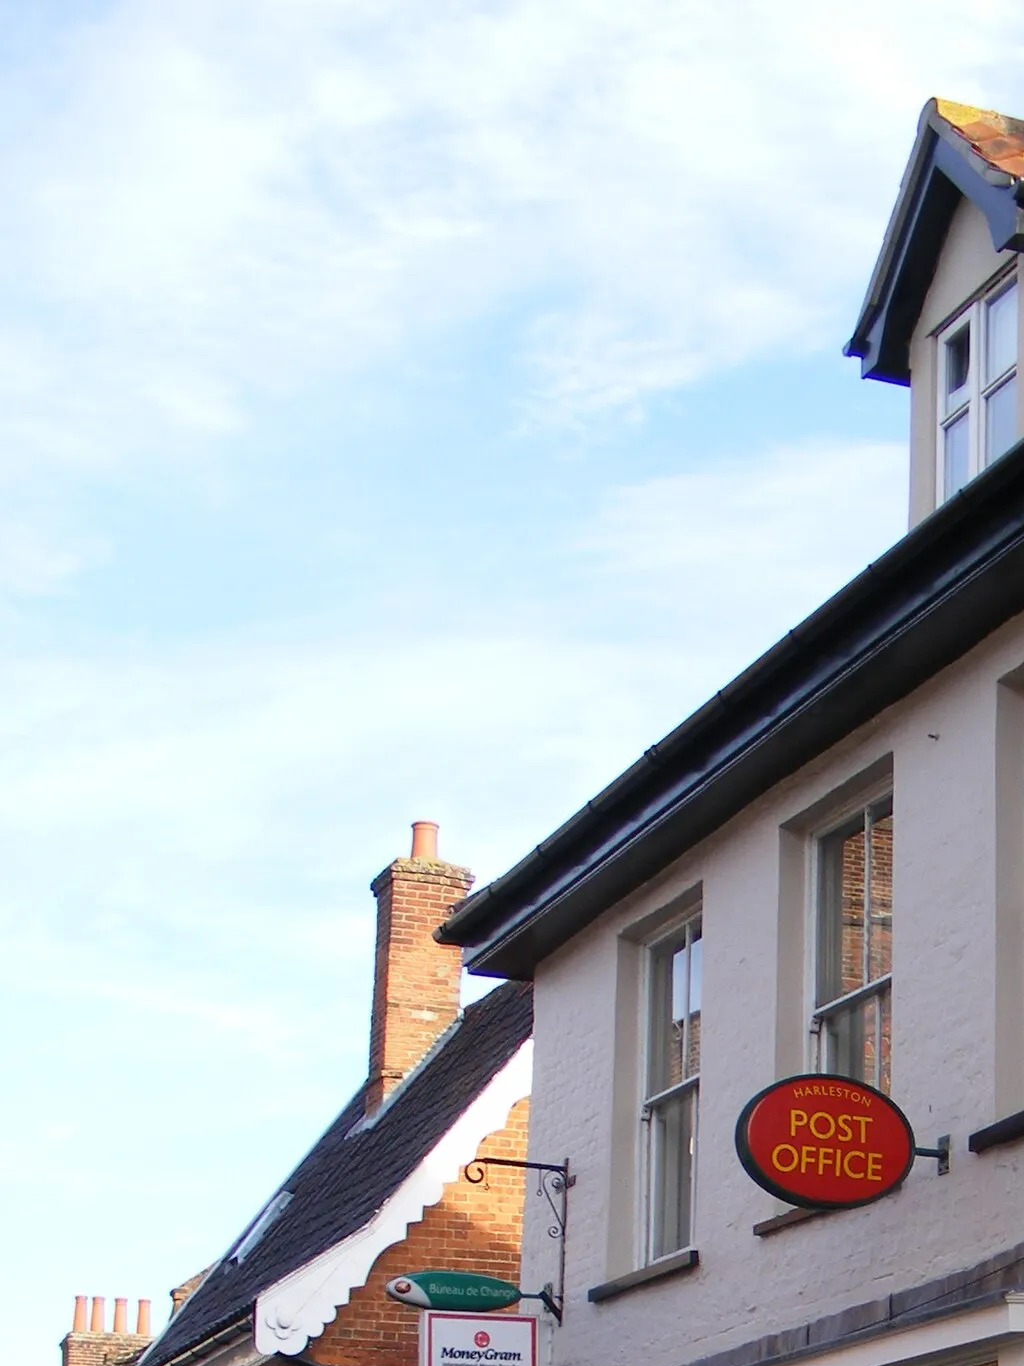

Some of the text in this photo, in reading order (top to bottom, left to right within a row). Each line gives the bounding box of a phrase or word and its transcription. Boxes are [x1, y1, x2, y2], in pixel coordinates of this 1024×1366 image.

[793, 1085, 871, 1107] HARLESTON
[790, 1109, 874, 1144] POST
[771, 1143, 883, 1181] OFFICE
[429, 1284, 516, 1300] Bureau de Change
[440, 1347, 521, 1362] MoneyGram
